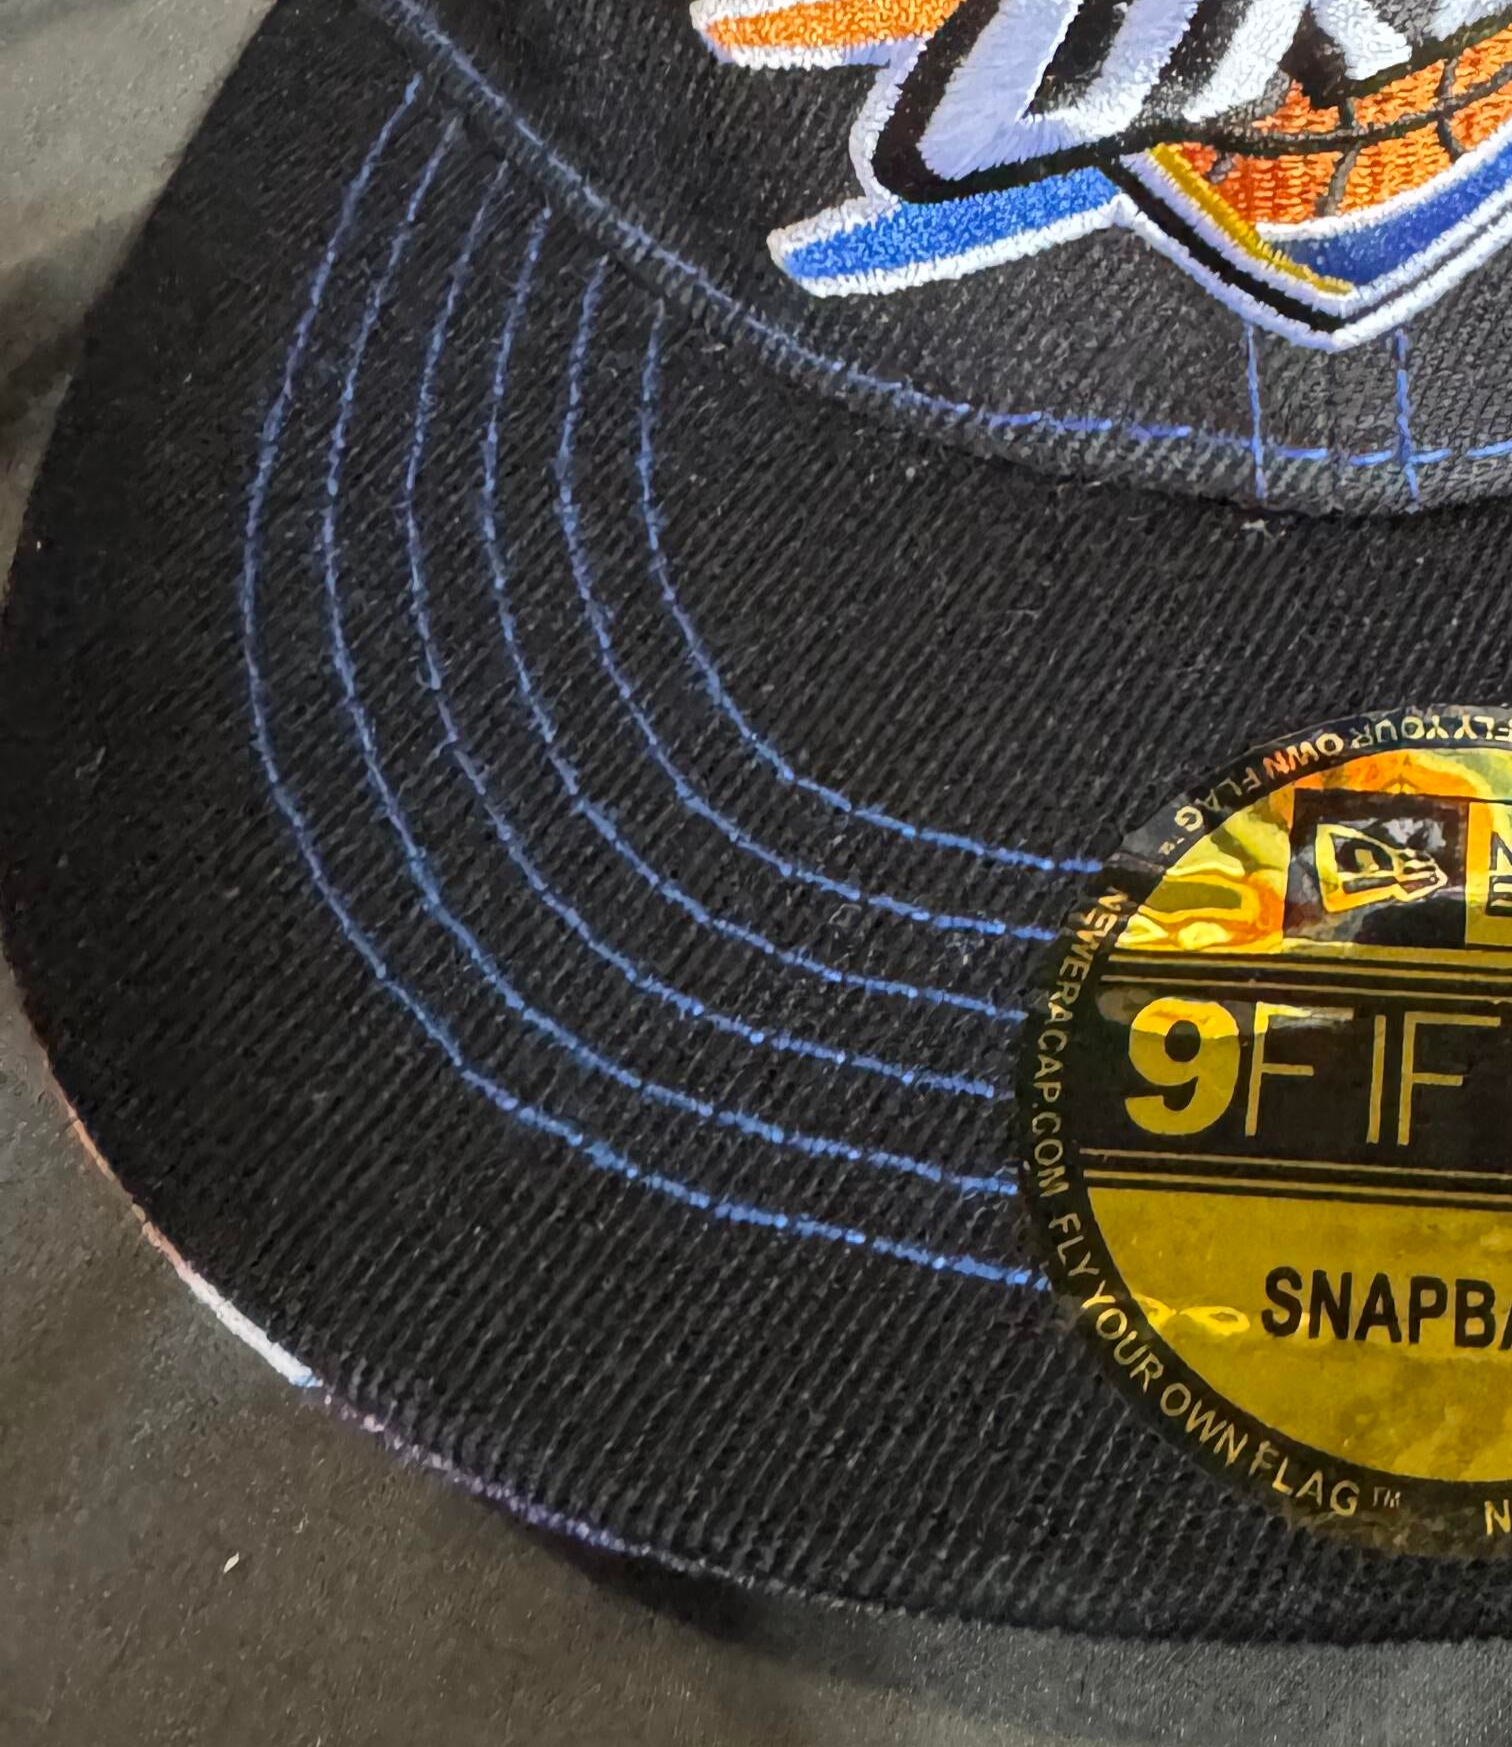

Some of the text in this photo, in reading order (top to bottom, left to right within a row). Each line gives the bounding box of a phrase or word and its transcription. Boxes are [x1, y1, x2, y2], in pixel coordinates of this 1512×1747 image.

[1262, 731, 1345, 780] OWN
[1350, 713, 1450, 750] YOUR
[1173, 765, 1263, 833] FLAG
[1030, 885, 1129, 1199] NEWERACAP.COM
[1047, 1210, 1101, 1277] FLY
[1080, 1279, 1165, 1393] YOUR
[1159, 1382, 1249, 1467] OWN
[1248, 1440, 1361, 1517] FLAG
